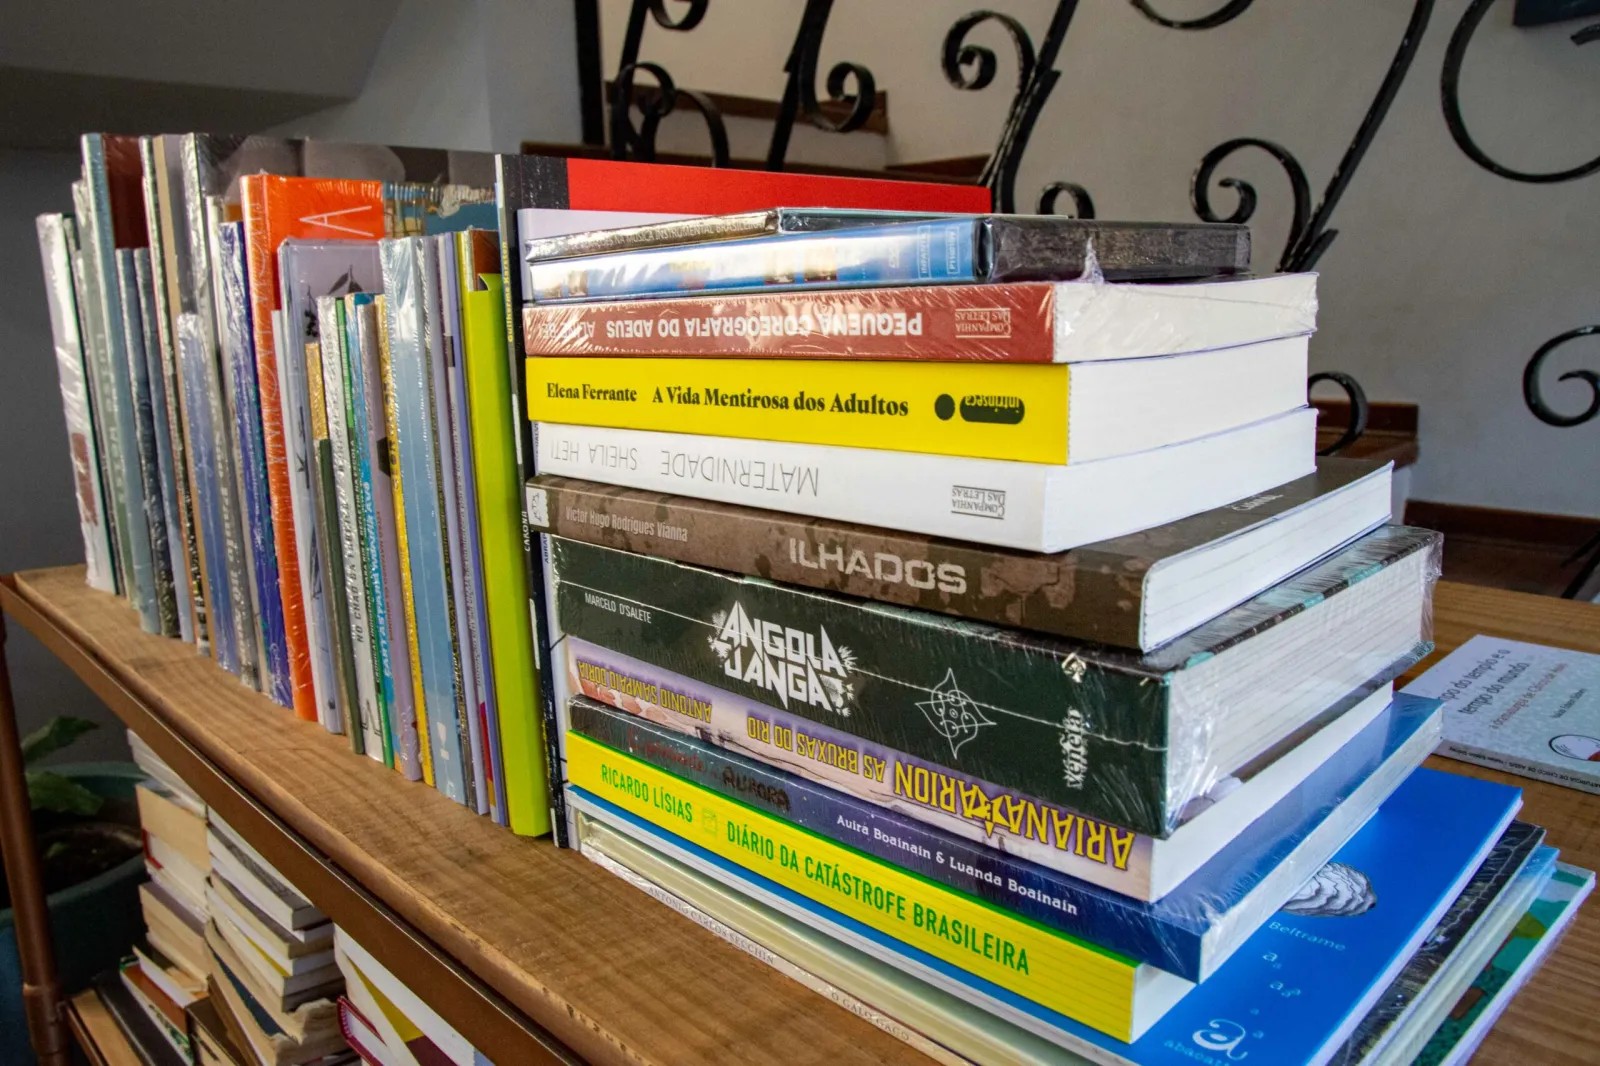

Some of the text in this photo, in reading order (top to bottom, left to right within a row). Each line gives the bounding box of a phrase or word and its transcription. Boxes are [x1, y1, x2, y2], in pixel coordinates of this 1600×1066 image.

[654, 223, 712, 241] INSTRUMENTAL
[501, 241, 514, 342] Guilherme Karsten
[606, 312, 923, 339] PEQUENA COREOGRAFIA DO ADEUS
[955, 310, 1011, 323] DAS LETRAS
[955, 321, 1012, 337] COMPANHIA
[547, 382, 638, 403] Elena Ferrante
[652, 386, 909, 417] A Vida Mentirosa dos Adultos
[350, 439, 358, 477] ESCOLA
[550, 439, 579, 463] HETI
[588, 440, 637, 472] SHEILA
[660, 449, 819, 497] MATERNIDADE
[951, 488, 1006, 505] DAS LETRAS
[951, 499, 1005, 517] COMPANHIA
[521, 510, 531, 552] CARONA
[565, 507, 688, 543] Victor Hugo Rodrigues Vianna
[788, 538, 967, 594] ILHADOS
[585, 592, 653, 625] MARCELO D'SALETE
[353, 625, 364, 644] NO
[718, 600, 847, 678] ANGOLA
[608, 670, 658, 706] SAMPAIO
[723, 646, 833, 712] JANGA
[1458, 662, 1531, 715] tempo do mundo
[659, 690, 713, 724] ANTONIO
[746, 716, 887, 784] AS BRUXAS DO RIO
[601, 763, 650, 803] RICARDO
[653, 785, 693, 823] LÍSIAS
[893, 760, 980, 819] ARION
[1004, 793, 1136, 872] ARIANA
[873, 828, 931, 860] Boainain
[935, 851, 946, 865] &
[949, 856, 1002, 887] Luanda
[1008, 879, 1078, 916] Boainain
[726, 817, 775, 868] DIÁRIO
[779, 845, 800, 873] DA
[805, 852, 906, 921] CATÁSTROFE
[913, 902, 1030, 976] BRASILEIRA
[648, 886, 775, 965] ANTONIO CARLOS SECCHIN
[1268, 921, 1346, 951] Beltrame
[842, 997, 874, 1021] GALO
